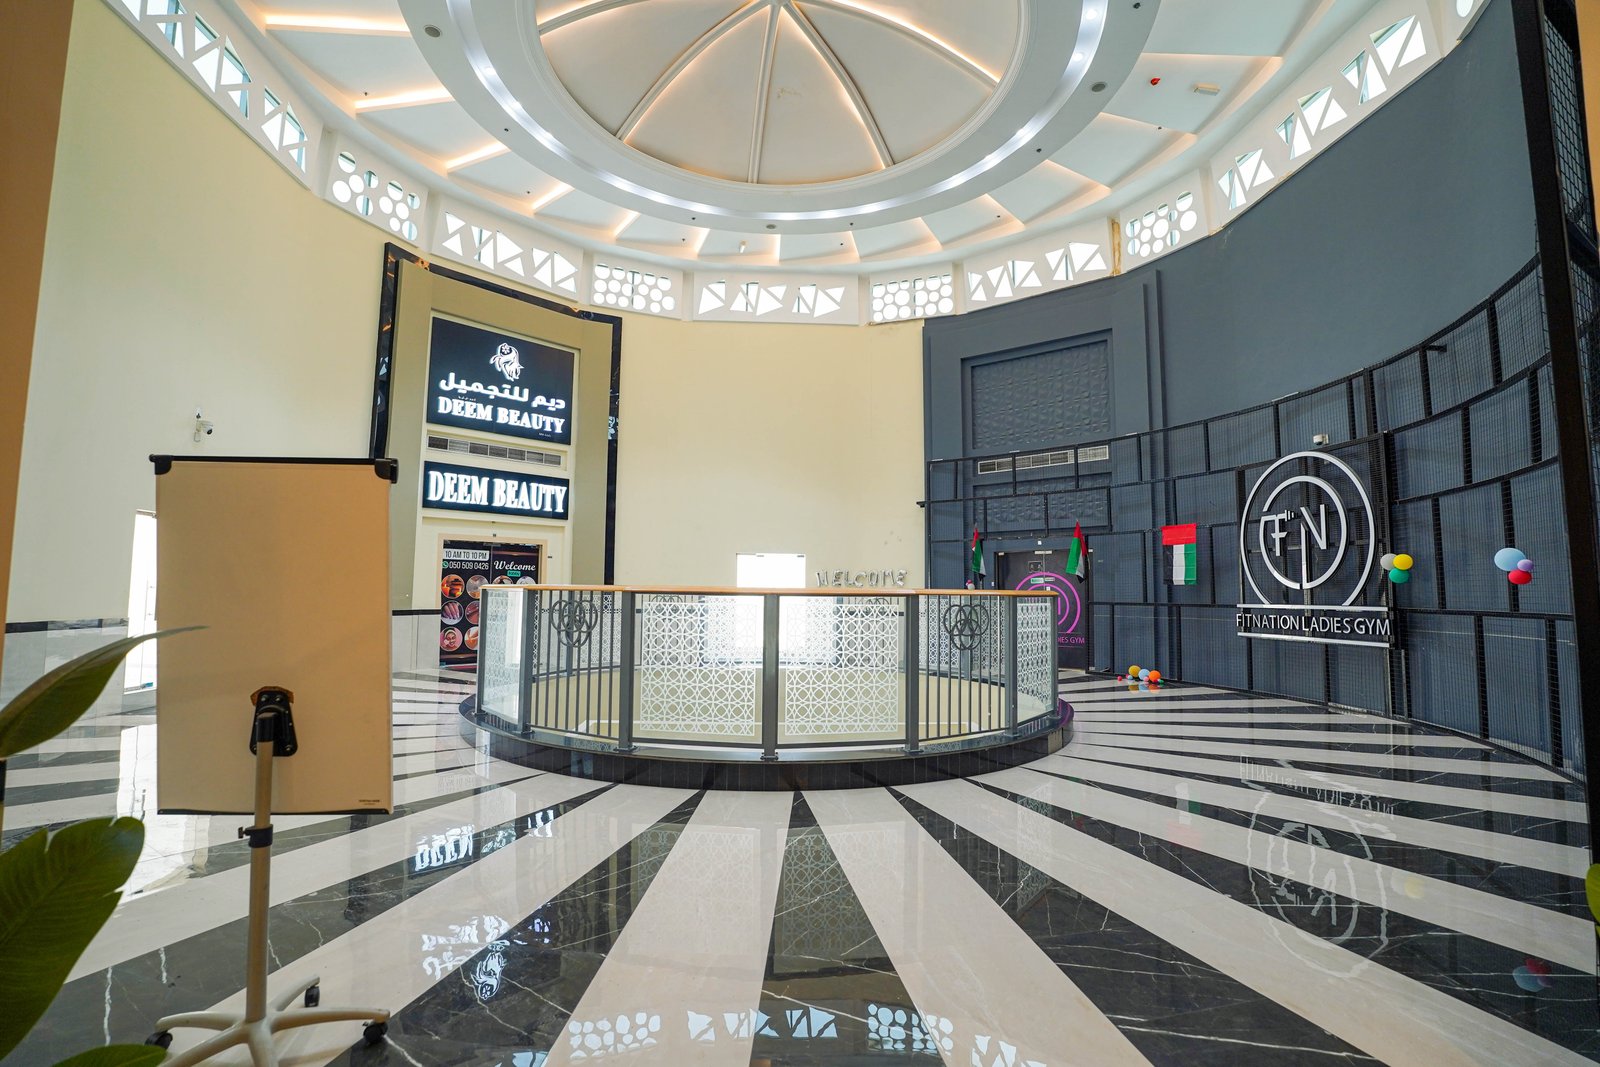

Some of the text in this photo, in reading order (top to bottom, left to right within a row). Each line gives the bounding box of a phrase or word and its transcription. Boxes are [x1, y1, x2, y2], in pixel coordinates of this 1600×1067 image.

[439, 372, 566, 411] ديم للتجميل
[438, 396, 566, 434] DEEM BEAUTY
[428, 470, 568, 513] DEEM BEAUTY
[445, 550, 487, 560] 10 AM TO 10 PM
[493, 560, 536, 571] Welcome
[816, 568, 907, 587] WELCOME
[1302, 616, 1351, 634] LADIES
[1354, 618, 1391, 636] GYM
[1069, 636, 1085, 644] GYM
